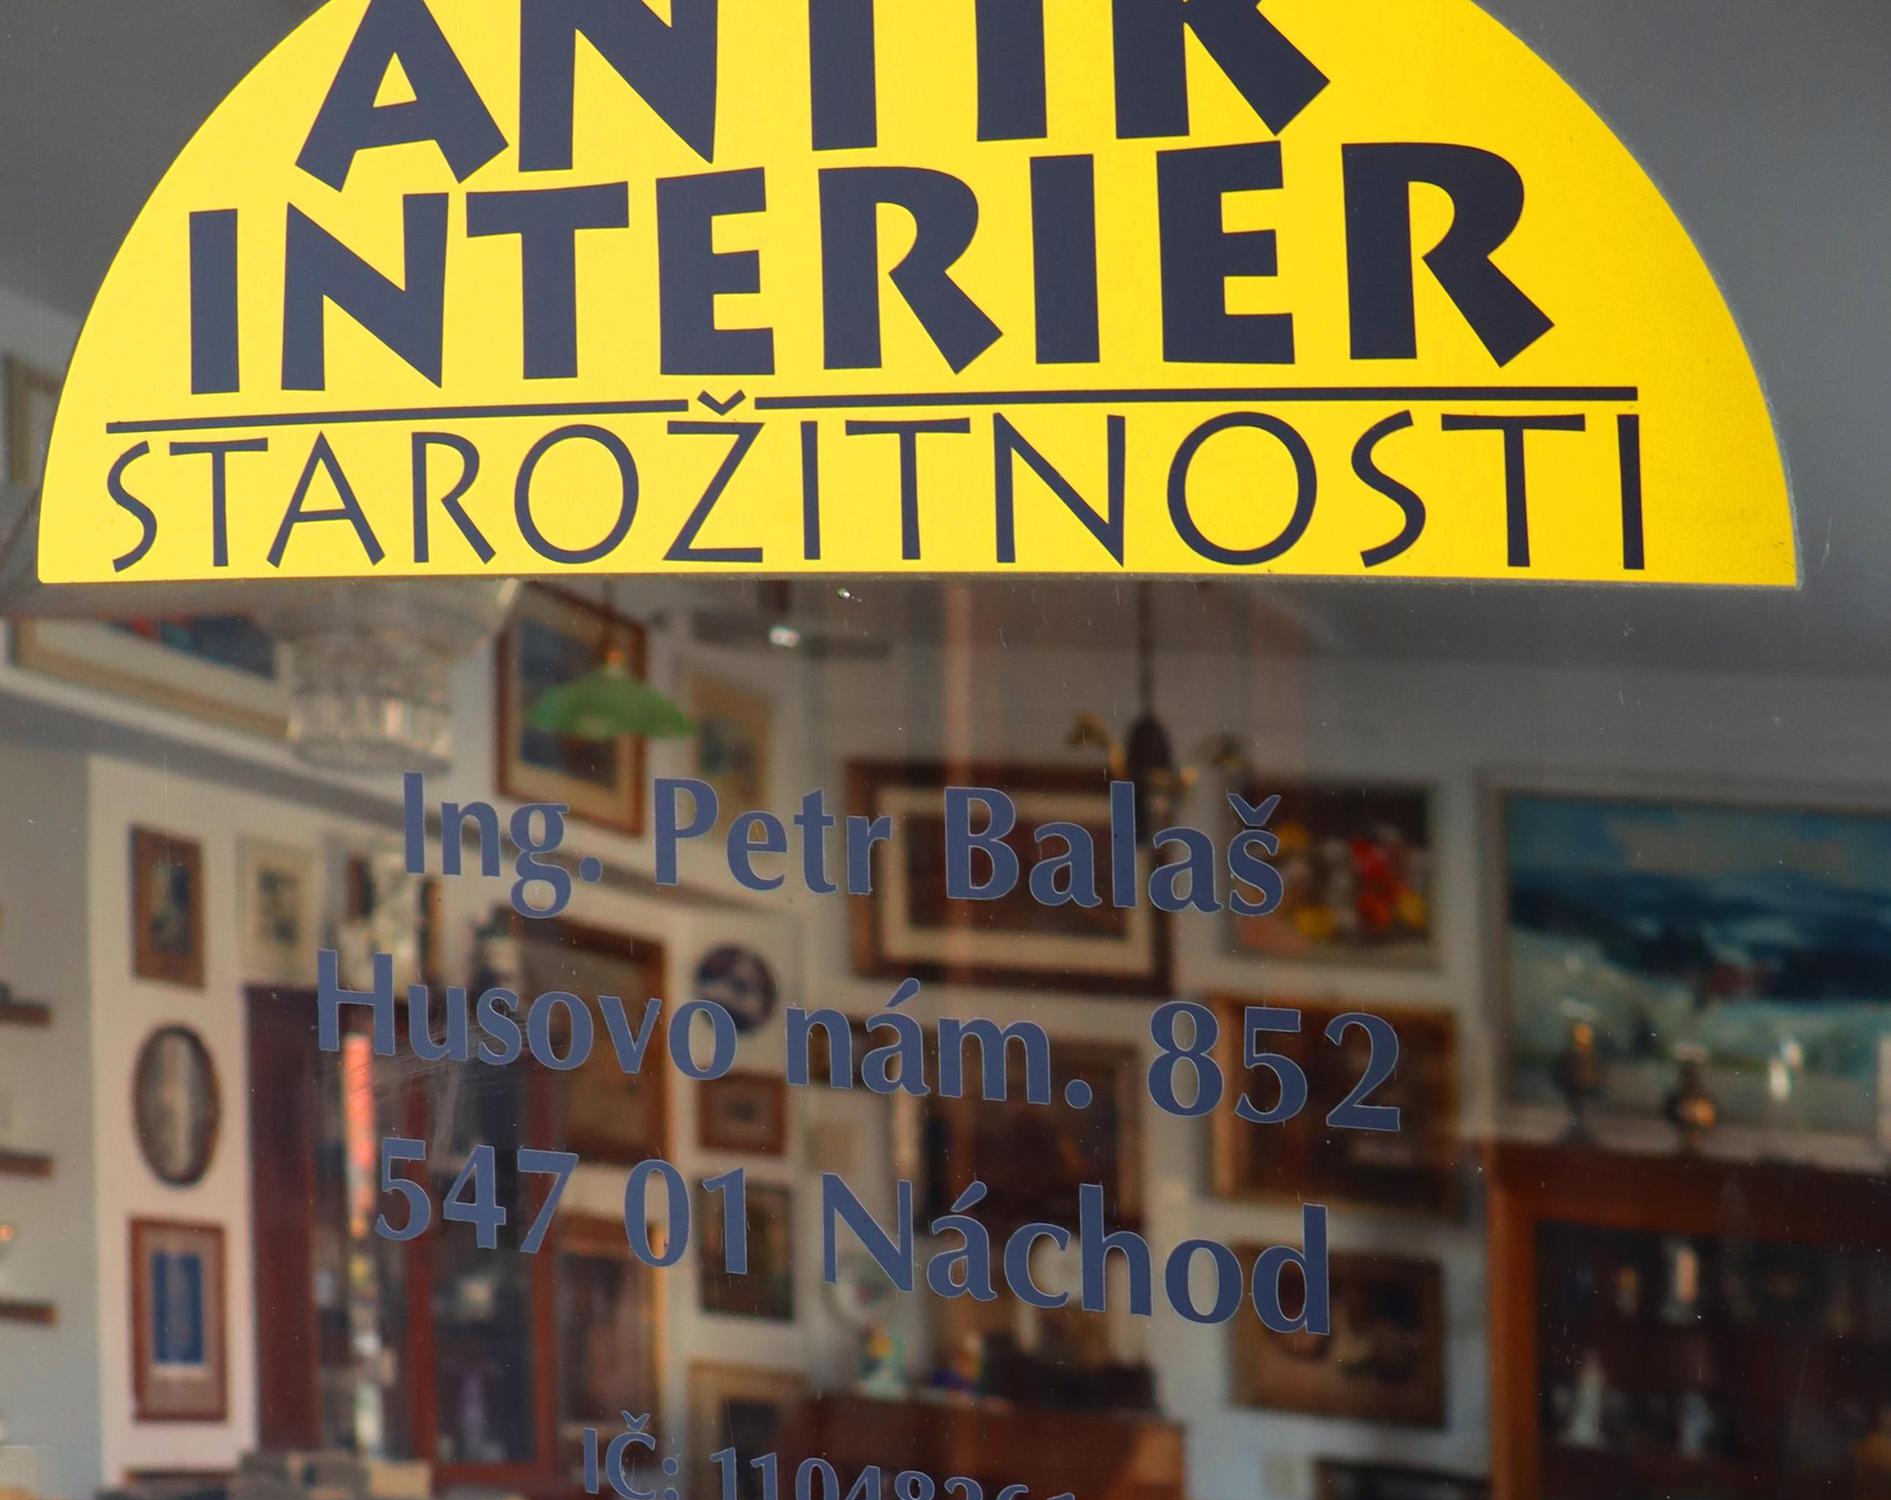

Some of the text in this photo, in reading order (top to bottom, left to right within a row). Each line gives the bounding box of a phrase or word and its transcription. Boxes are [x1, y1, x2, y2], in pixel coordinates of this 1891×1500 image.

[189, 141, 1556, 395] INTERIER
[105, 388, 1646, 573] STAROŽITNOSTI
[403, 771, 1285, 919] Ing. Petr Balaš
[316, 948, 1401, 1132] Husovo nám. 852
[374, 1137, 1331, 1336] 547 01 Náchod
